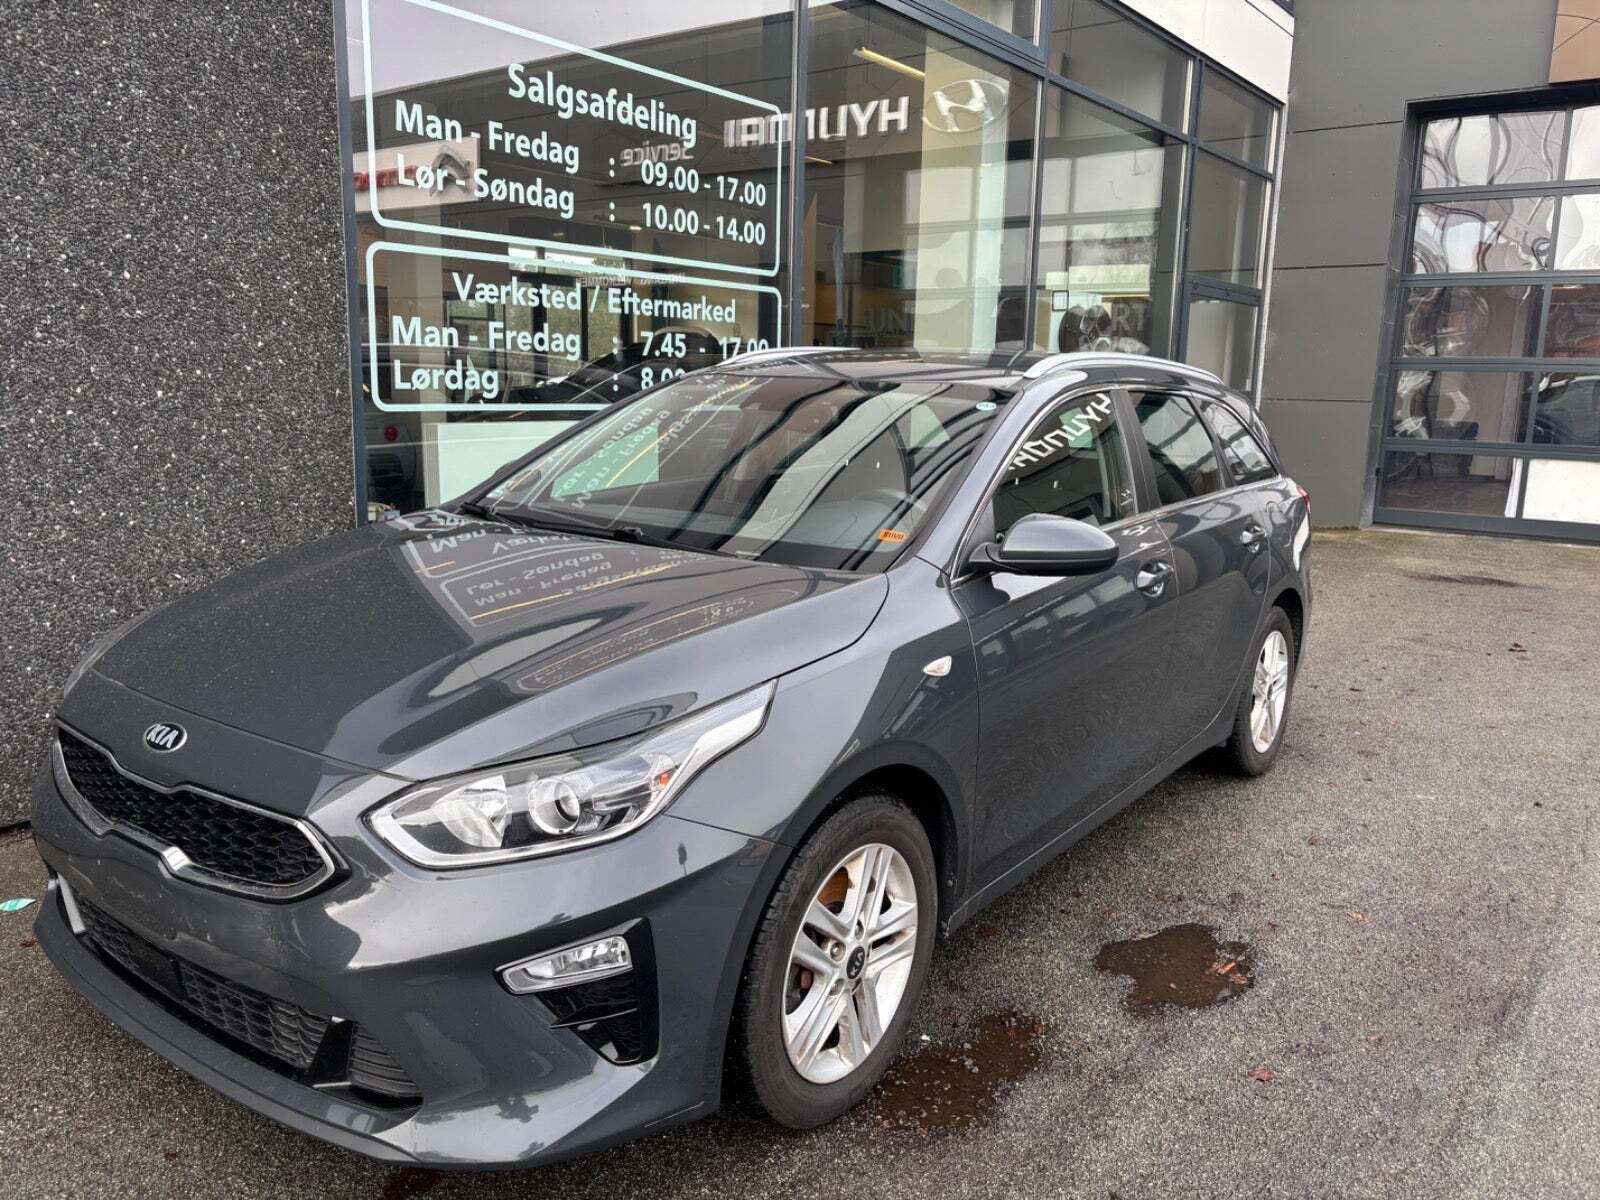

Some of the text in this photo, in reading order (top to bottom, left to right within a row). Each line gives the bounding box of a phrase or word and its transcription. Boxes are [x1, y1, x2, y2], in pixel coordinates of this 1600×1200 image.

[508, 63, 697, 149] Salgsafdeling
[395, 100, 462, 143] Man
[488, 121, 579, 174] Fredag
[641, 159, 699, 194] 09.00
[716, 175, 767, 206] 17.00
[398, 153, 448, 192] Lør
[473, 167, 575, 219] Søndag
[642, 202, 699, 234] 10.00
[716, 216, 766, 246] 14.00
[452, 271, 736, 324] Værksted / Eftermarked
[392, 316, 459, 348] Man
[488, 321, 581, 361] Fredag
[641, 331, 687, 358] 7.45
[720, 336, 769, 360] 1700
[393, 359, 499, 402] Lørdag
[146, 724, 179, 749] KIA
